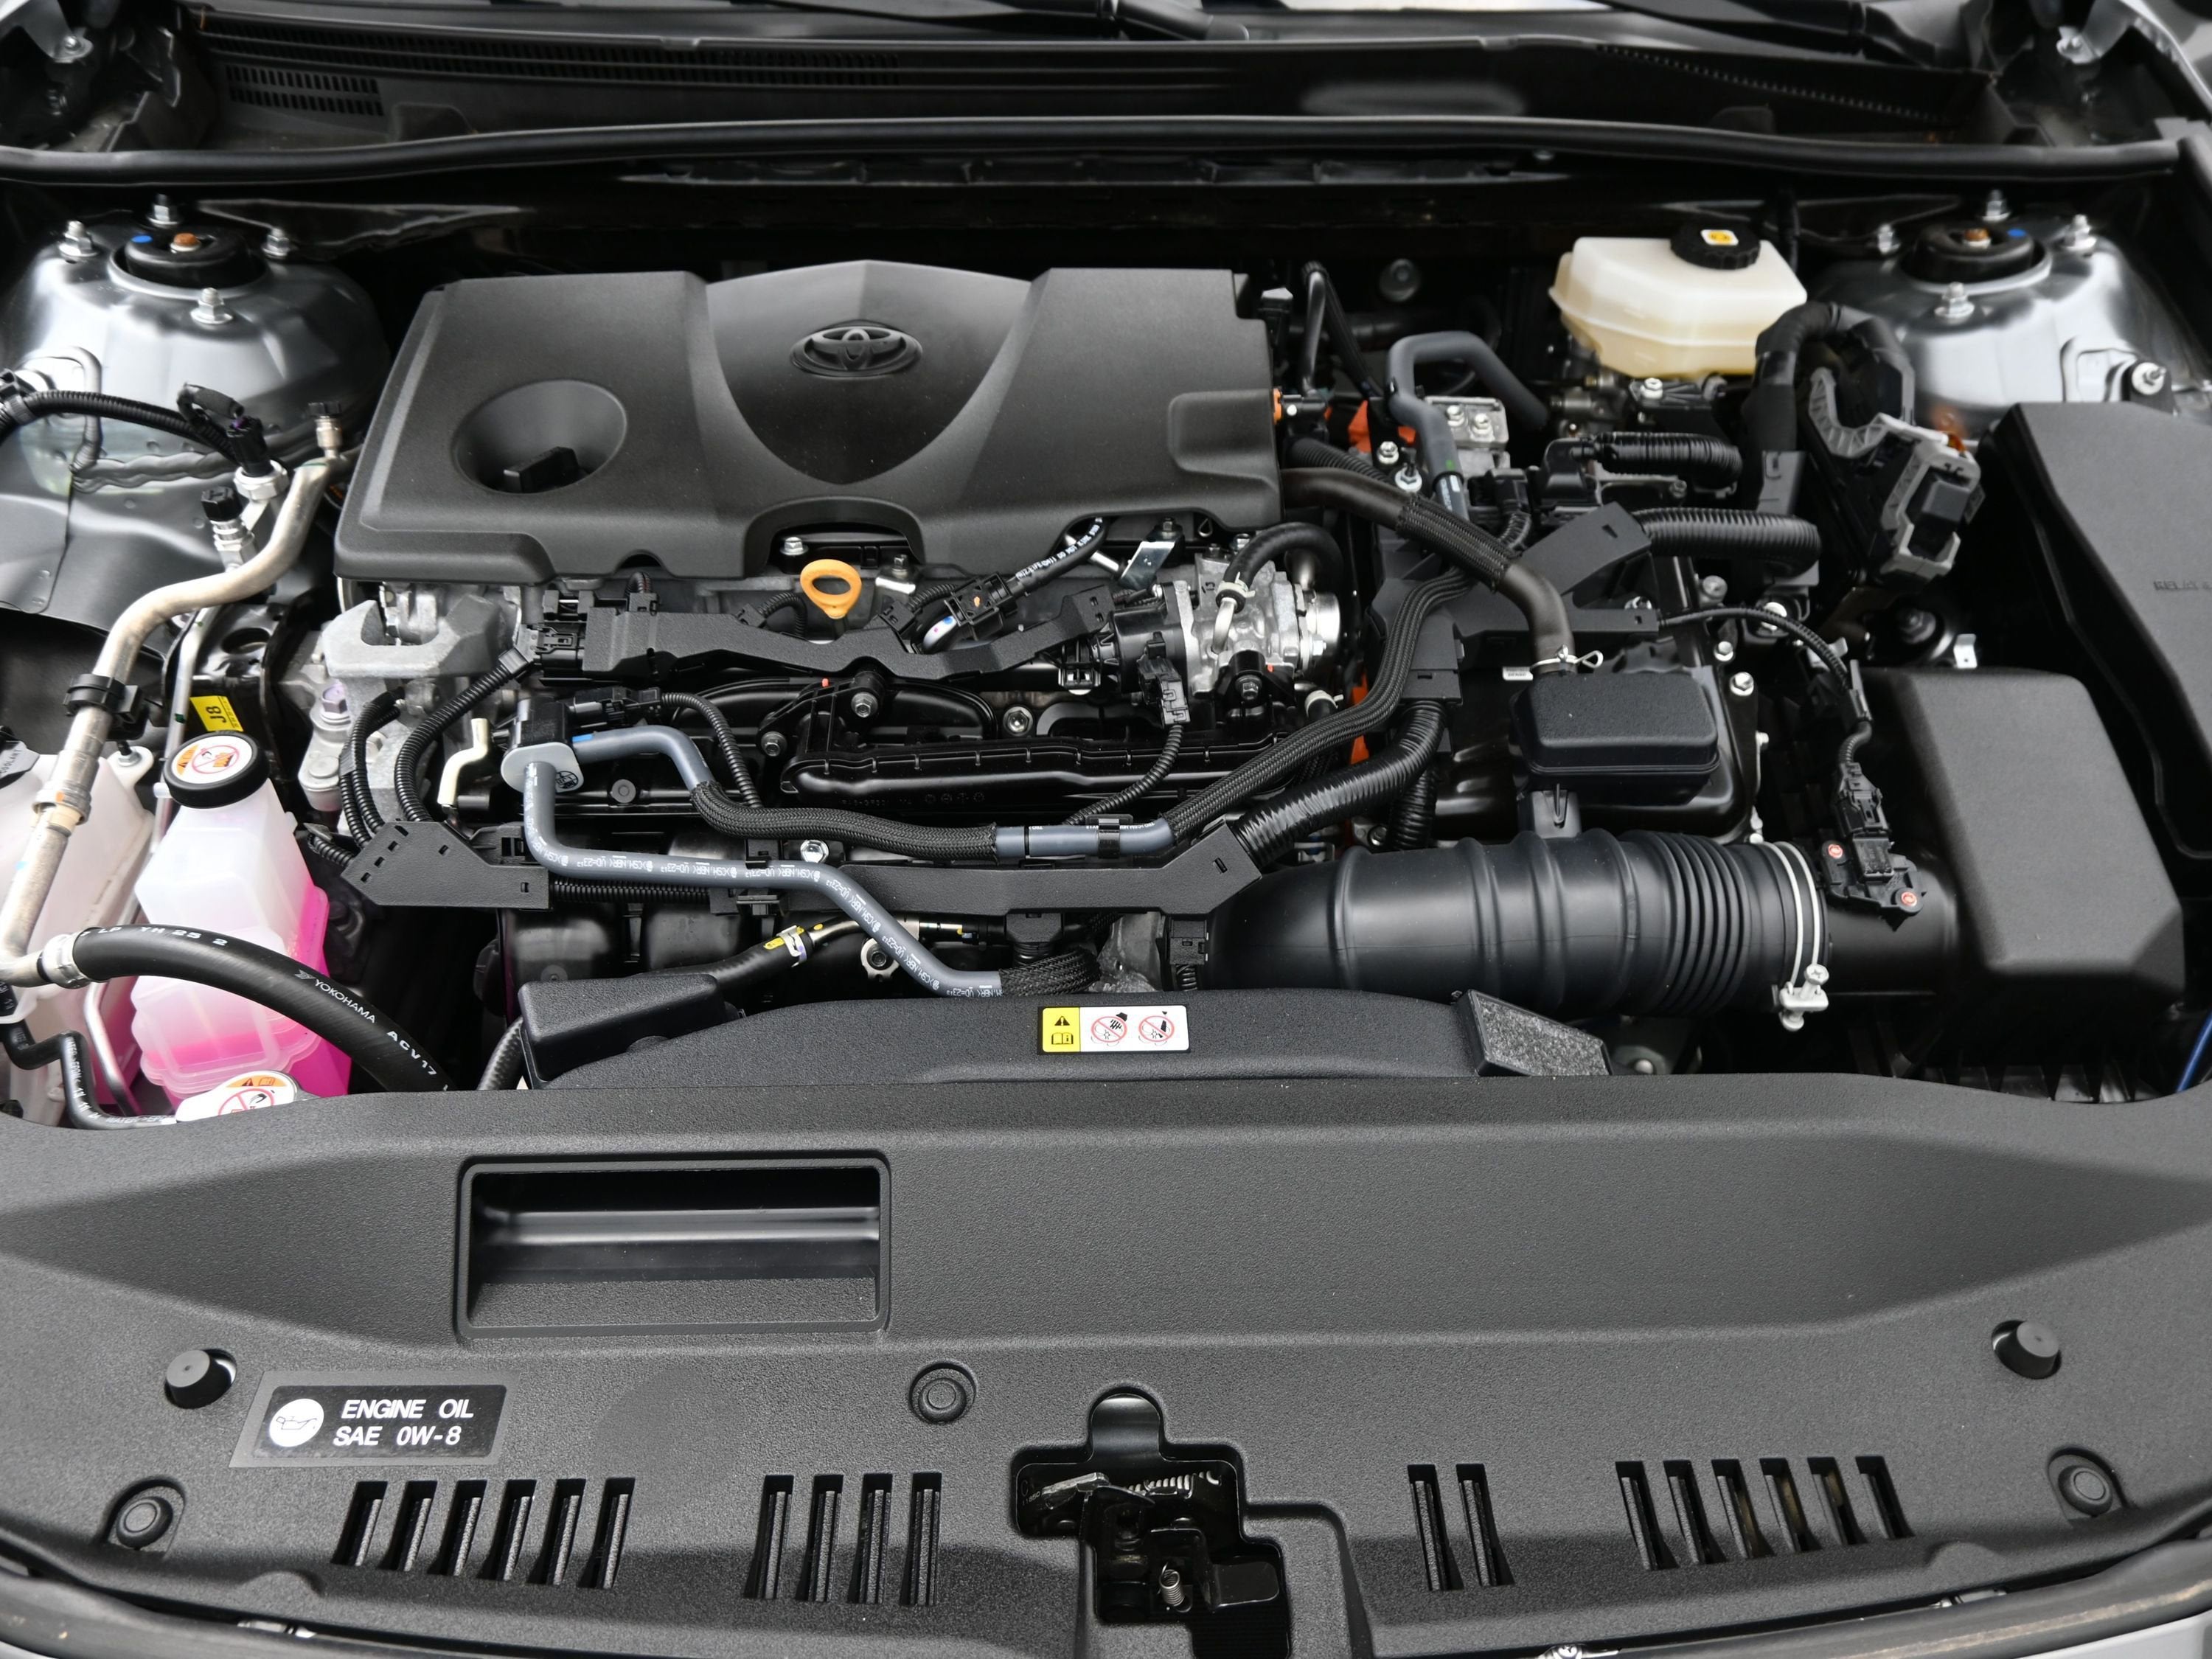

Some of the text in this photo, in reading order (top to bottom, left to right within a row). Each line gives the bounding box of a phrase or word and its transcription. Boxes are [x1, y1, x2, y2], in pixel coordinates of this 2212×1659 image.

[205, 705, 227, 723] J8
[97, 926, 123, 934] LP
[141, 926, 166, 934] YH
[171, 929, 202, 939] 25
[212, 938, 229, 947] 2
[314, 978, 437, 1077] YOKOHAMA ACV17
[341, 1398, 474, 1419] ENGINE OIL
[333, 1425, 462, 1446] SAE 0W-8
